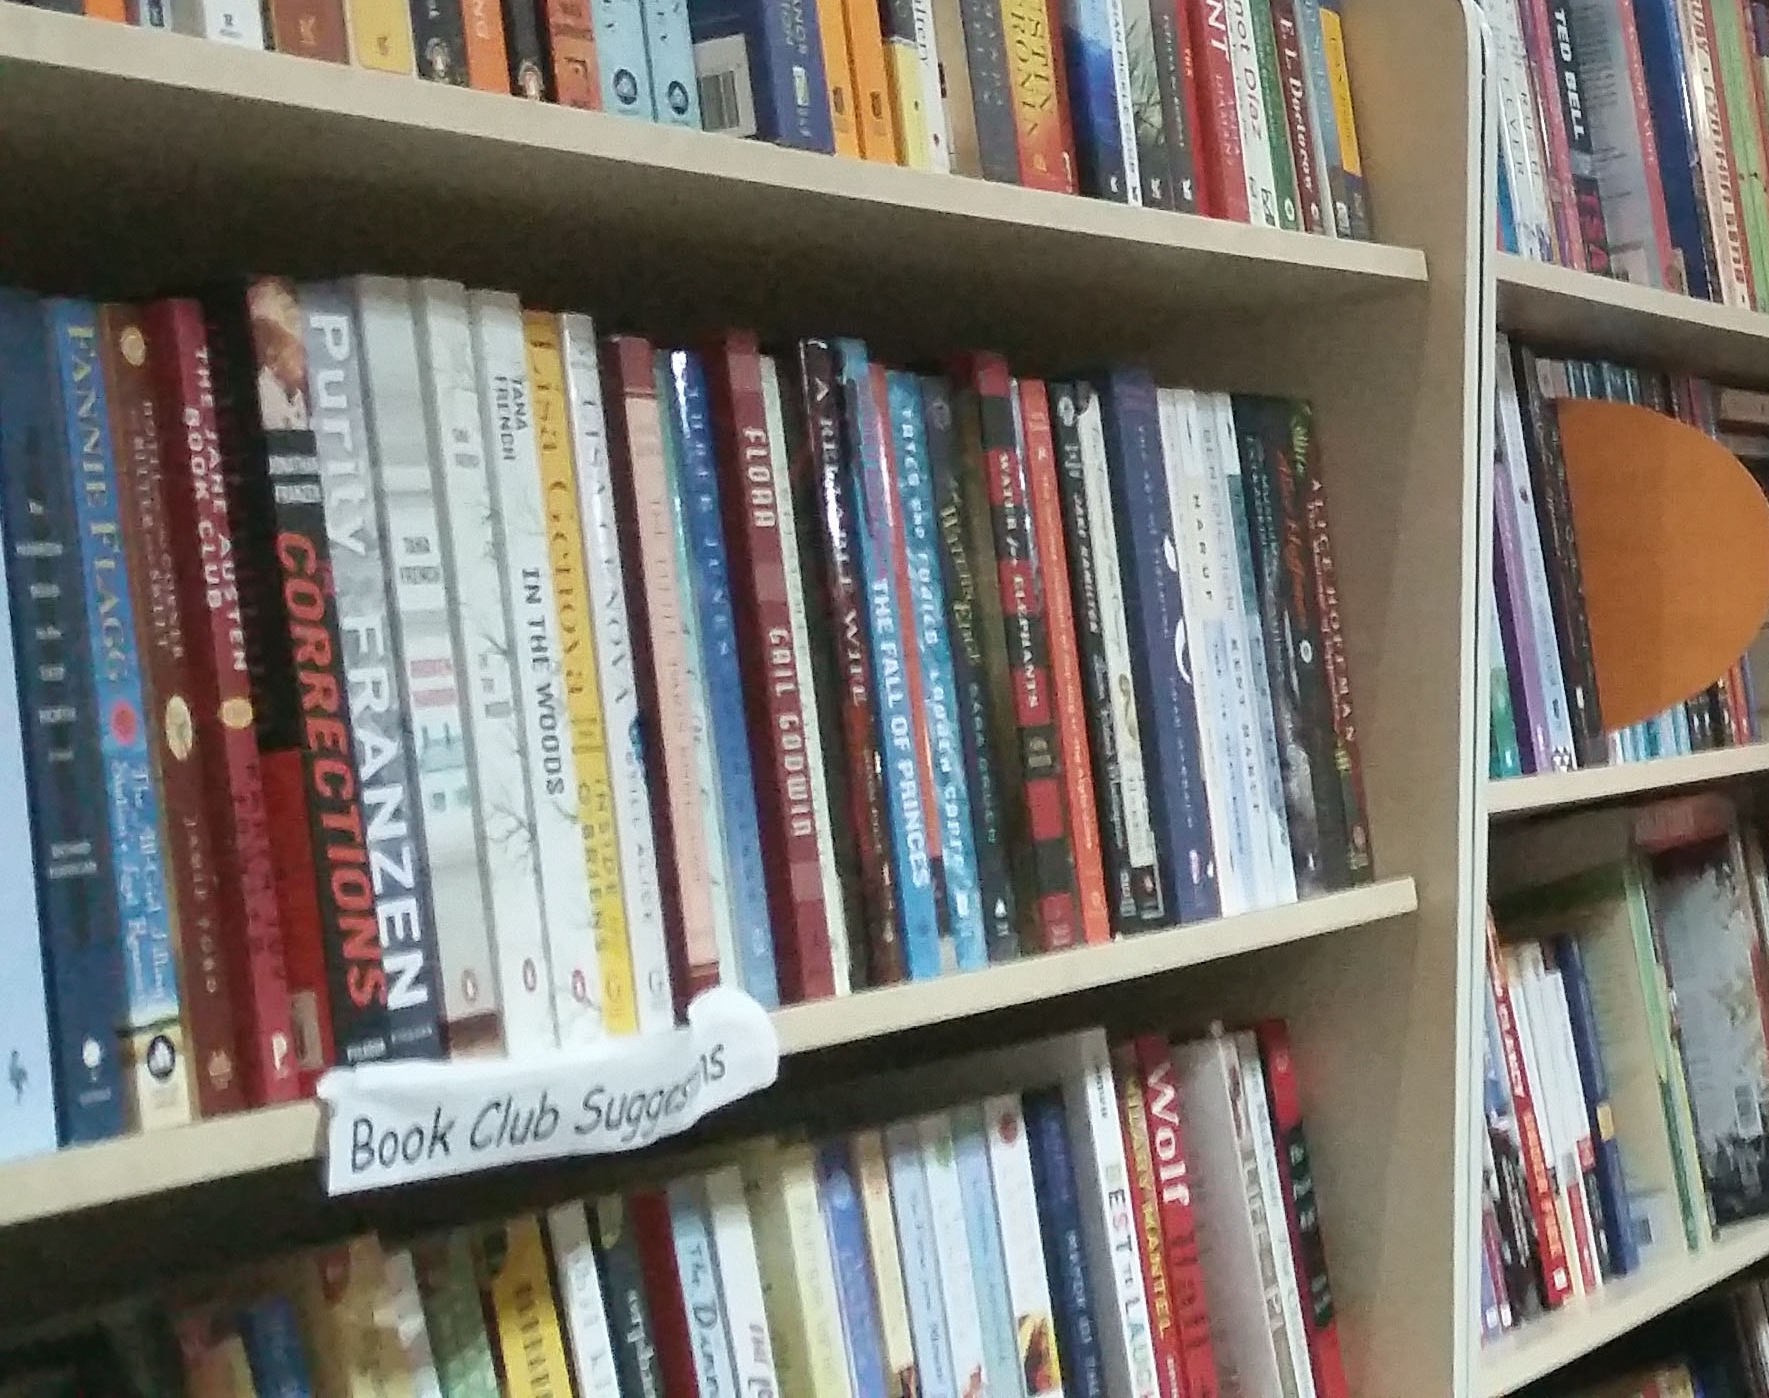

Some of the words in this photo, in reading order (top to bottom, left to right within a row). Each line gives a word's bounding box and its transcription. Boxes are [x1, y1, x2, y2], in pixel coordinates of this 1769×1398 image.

[1279, 16, 1296, 40] E.
[1283, 47, 1299, 70] L.
[1553, 9, 1573, 64] TED
[1564, 70, 1586, 141] BELL
[193, 345, 215, 407] THE
[493, 375, 519, 462] FRENCH
[510, 376, 529, 433] TANA
[183, 407, 213, 501] BOOK
[202, 429, 228, 515] JANE
[742, 426, 777, 528] FLORA
[66, 323, 108, 509] FANNIE
[89, 521, 130, 683] FLAGG
[196, 521, 226, 610] CLUB
[216, 536, 249, 673] AUSTEN
[520, 567, 543, 605] IN
[872, 577, 896, 634] THE
[998, 453, 1019, 533] WATER
[1011, 574, 1040, 709] ELEPHANTS
[308, 311, 368, 558] Purity
[342, 613, 430, 1012] FRANZEN
[525, 612, 551, 667] THE
[768, 627, 798, 699] GAIL
[844, 609, 868, 707] WIFE
[879, 640, 905, 709] FALL
[275, 530, 392, 1010] CORRECTIONS
[534, 684, 566, 798] WOODS
[775, 713, 814, 838] GODWIN
[888, 716, 911, 753] OF
[897, 758, 932, 889] PRINCES
[351, 1107, 456, 1175] Book
[470, 1092, 560, 1150] Club
[1147, 1062, 1190, 1207] Wolf
